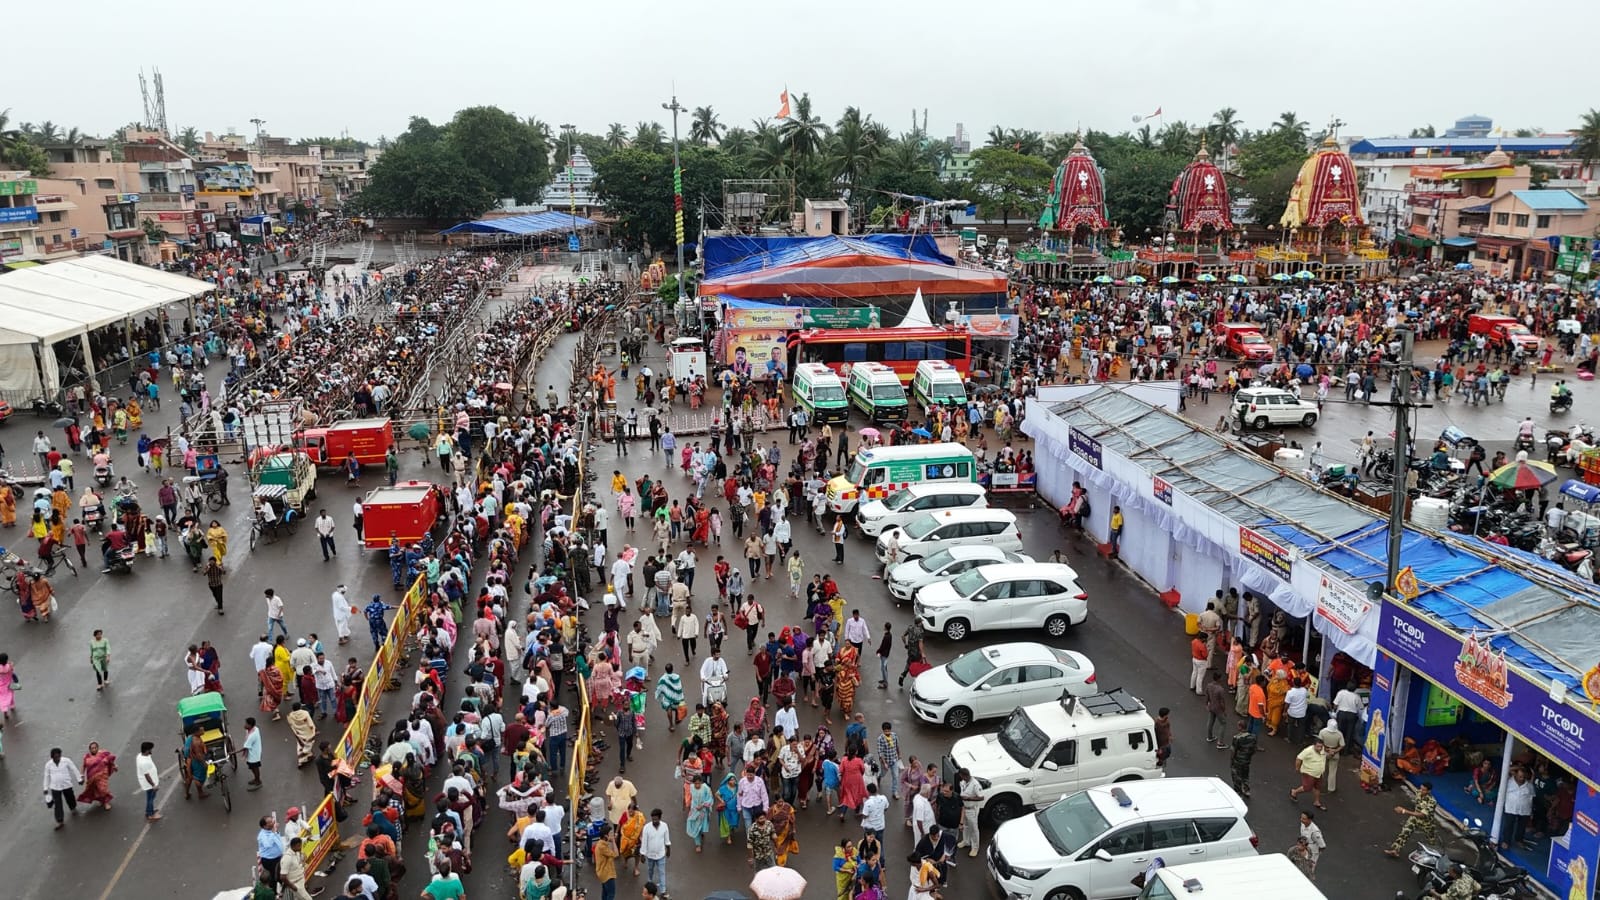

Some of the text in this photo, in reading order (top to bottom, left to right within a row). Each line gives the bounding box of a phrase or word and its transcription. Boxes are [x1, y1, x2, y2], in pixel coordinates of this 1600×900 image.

[1251, 543, 1275, 562] CONTROL
[1275, 556, 1291, 572] ROOM
[1392, 615, 1427, 644] TPCODL
[1541, 704, 1585, 742] TPCODL
